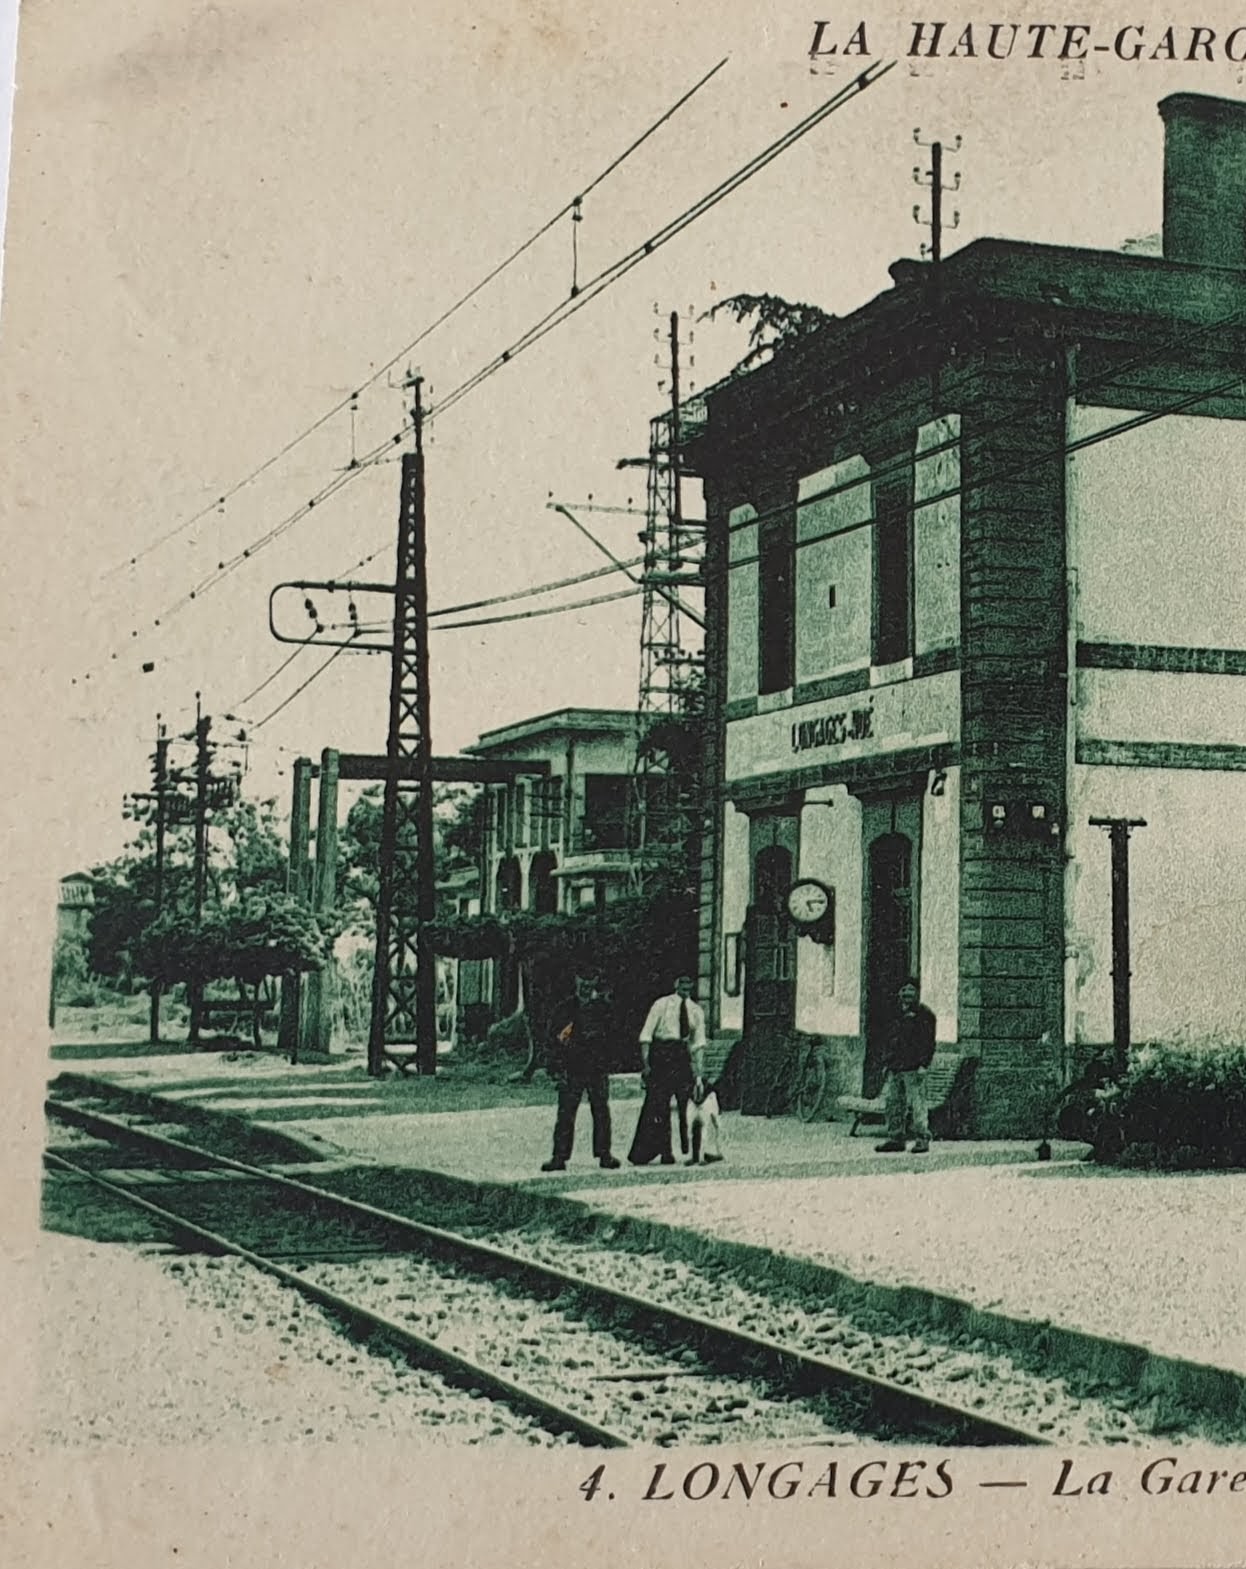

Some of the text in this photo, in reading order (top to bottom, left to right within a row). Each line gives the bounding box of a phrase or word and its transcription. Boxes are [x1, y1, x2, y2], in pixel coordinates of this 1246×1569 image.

[807, 20, 871, 58] LA
[579, 1464, 616, 1502] 4.
[641, 1459, 953, 1501] LONGAGES
[1052, 1459, 1113, 1496] La
